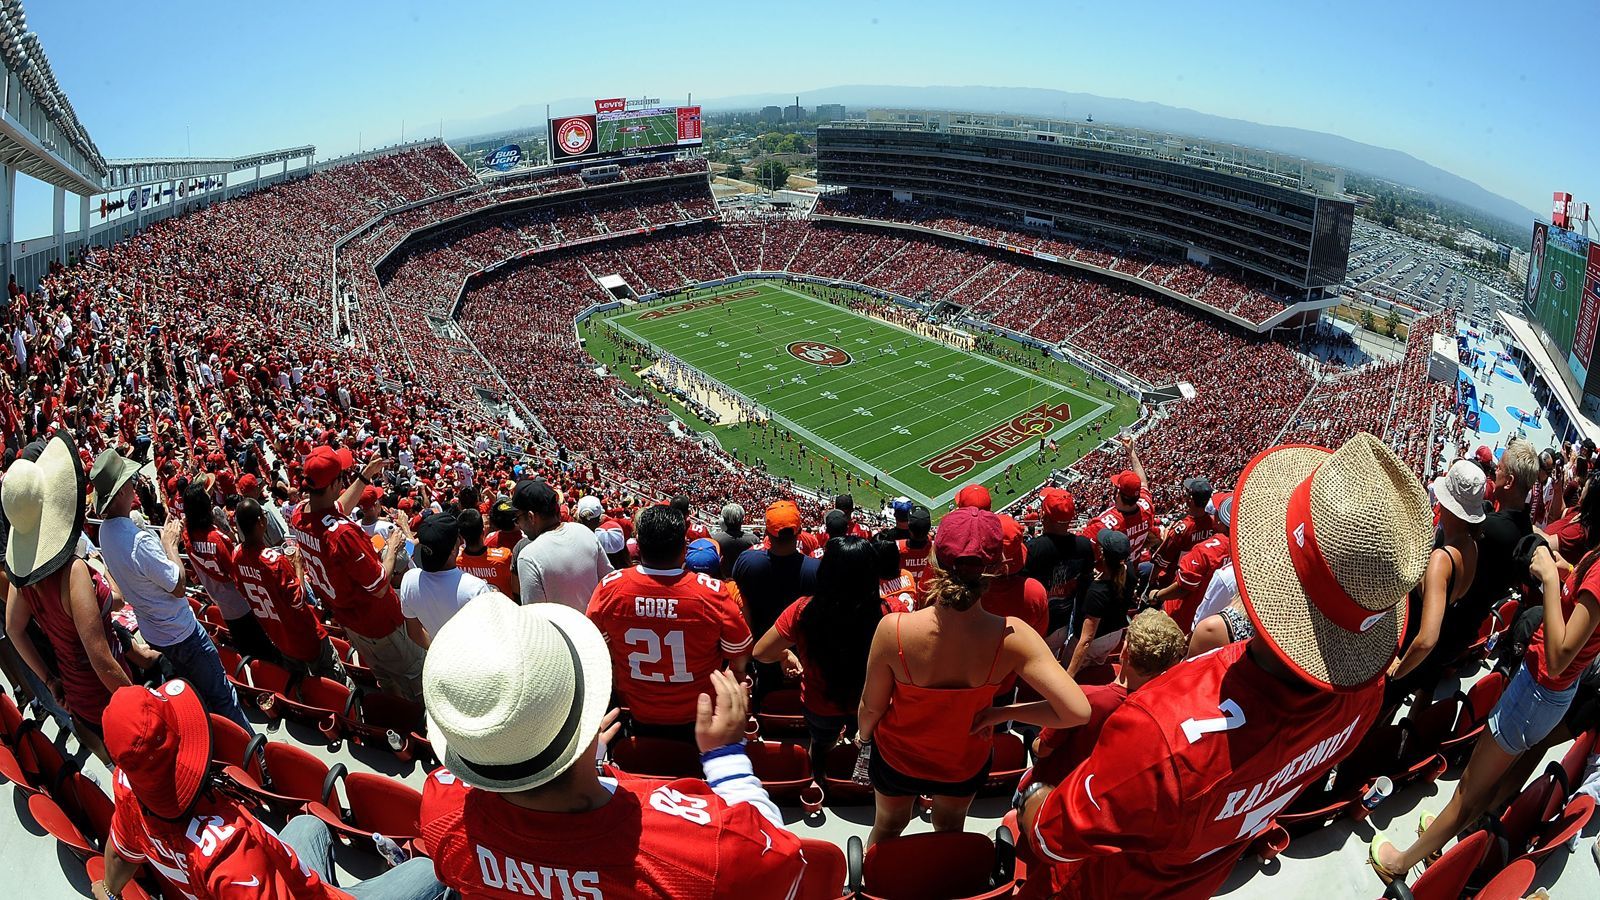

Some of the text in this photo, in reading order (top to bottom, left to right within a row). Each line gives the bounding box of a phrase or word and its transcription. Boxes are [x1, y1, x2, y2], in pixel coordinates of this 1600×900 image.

[490, 155, 520, 165] LIGHT
[495, 150, 517, 158] BUD
[636, 289, 760, 320] 49ERS
[919, 402, 1073, 482] 49ERS
[1126, 521, 1149, 537] WILLIS
[1191, 529, 1214, 542] WILLIS
[238, 564, 261, 580] WILLIS
[905, 558, 927, 568] WILLIS
[243, 582, 282, 622] 52
[634, 596, 679, 619] GORE
[624, 627, 694, 682] 21
[1180, 698, 1246, 744] 7
[186, 816, 236, 857] 52
[476, 844, 604, 900] DAVIS
